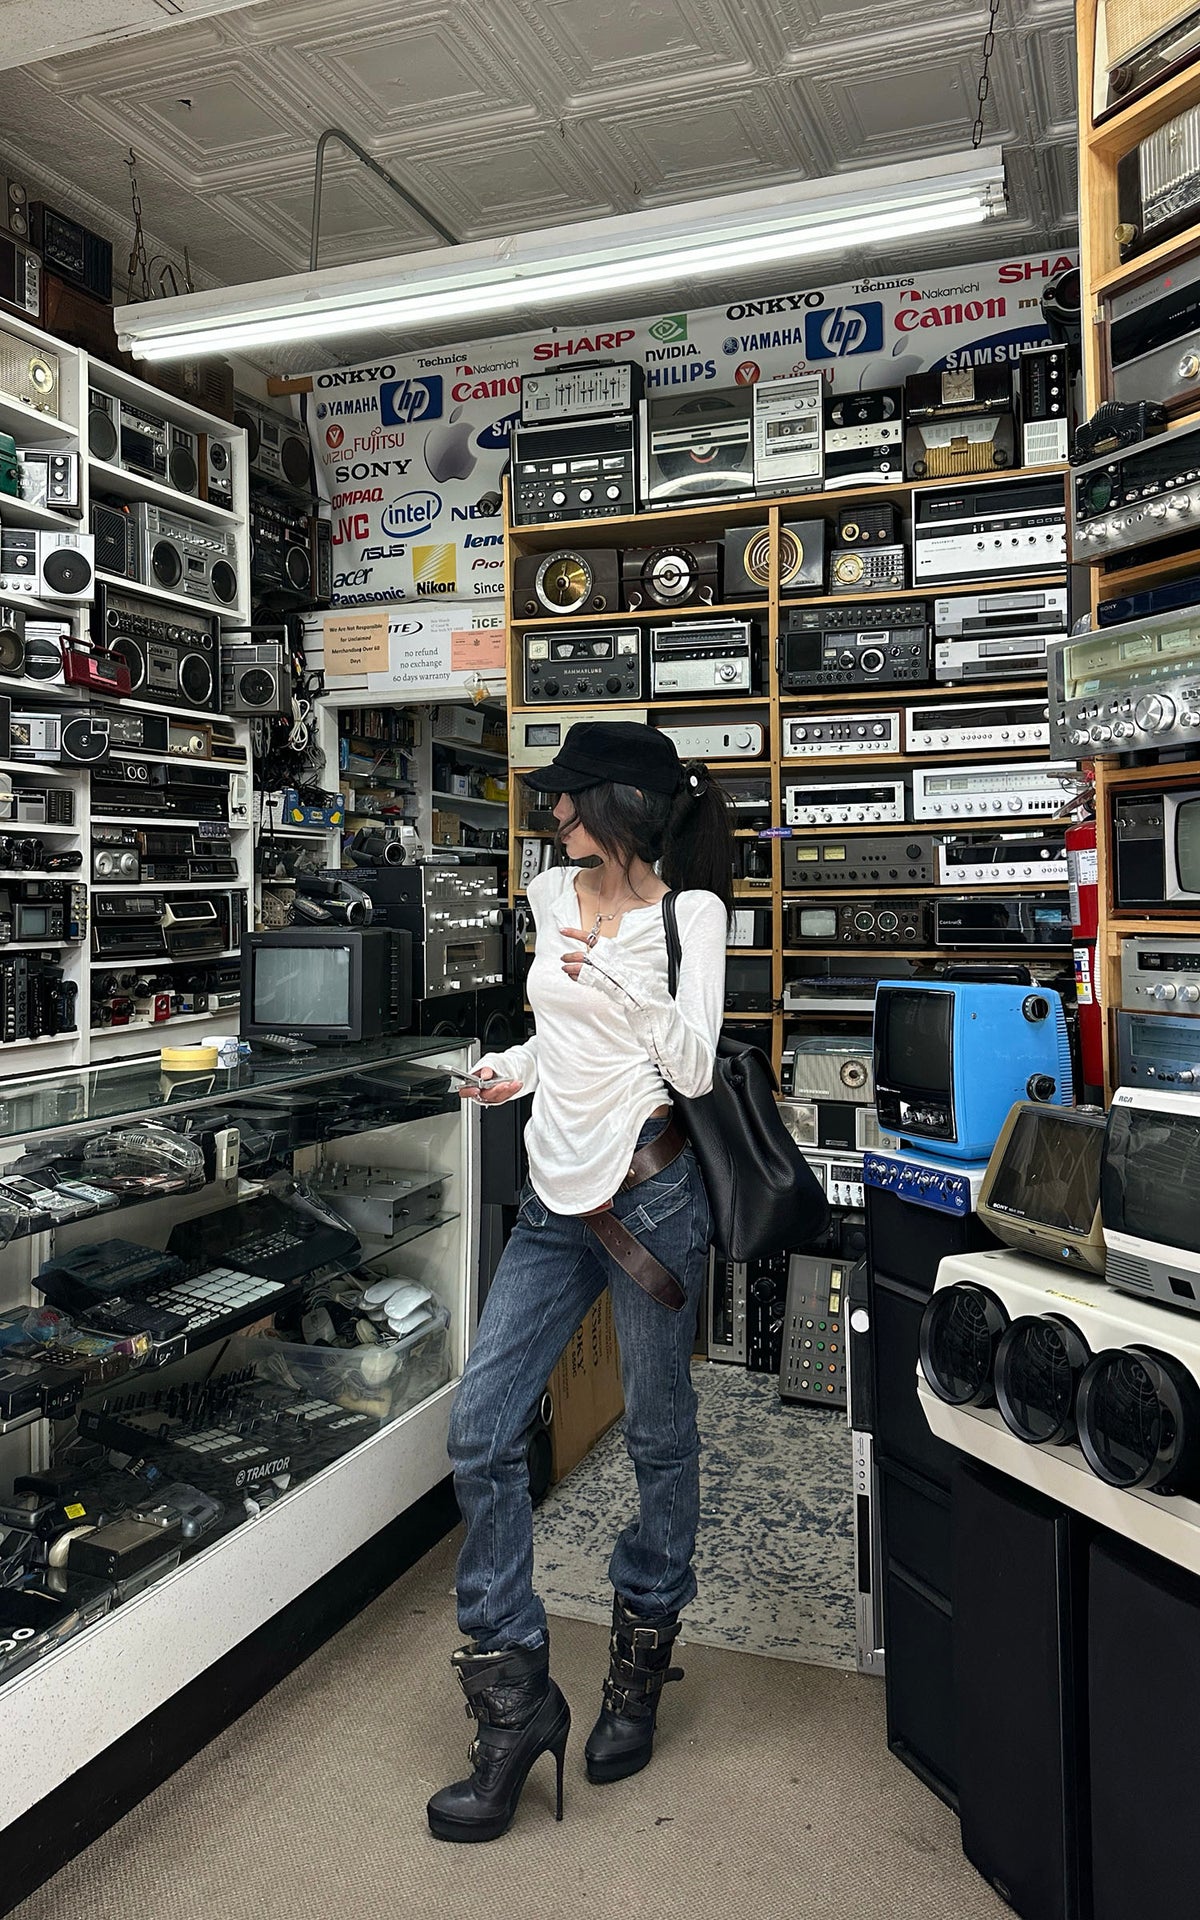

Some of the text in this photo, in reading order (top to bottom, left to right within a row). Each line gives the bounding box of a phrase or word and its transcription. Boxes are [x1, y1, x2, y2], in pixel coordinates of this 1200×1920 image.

[998, 255, 1079, 284] SHA
[852, 278, 915, 295] Technics
[921, 282, 980, 300] Nakamichi
[726, 291, 825, 321] ONKYO
[894, 297, 1006, 332] Canon
[533, 330, 636, 361] SHARP
[740, 327, 803, 352] YAMAHA
[417, 354, 468, 369] Technics
[473, 359, 520, 375] Nakamichi
[317, 365, 396, 389] ONKYO
[646, 360, 717, 388] HILIPS
[451, 376, 522, 403] Cano
[328, 396, 379, 416] YAMAHA
[354, 427, 405, 455] FUJITSU
[322, 449, 354, 466] VIZIO
[335, 459, 413, 484] SONY
[332, 487, 384, 511] COMPAQ
[388, 499, 432, 526] intel
[332, 513, 370, 546] JVC
[360, 544, 405, 562] ASUS
[333, 567, 374, 589] acer
[416, 581, 456, 596] Nikon
[473, 582, 505, 595] Since
[332, 586, 406, 606] Panasonic
[410, 659, 442, 669] exchange
[415, 648, 439, 657] refund
[402, 673, 418, 682] days
[419, 672, 451, 681] warranty
[246, 1456, 291, 1482] TRAKTOR
